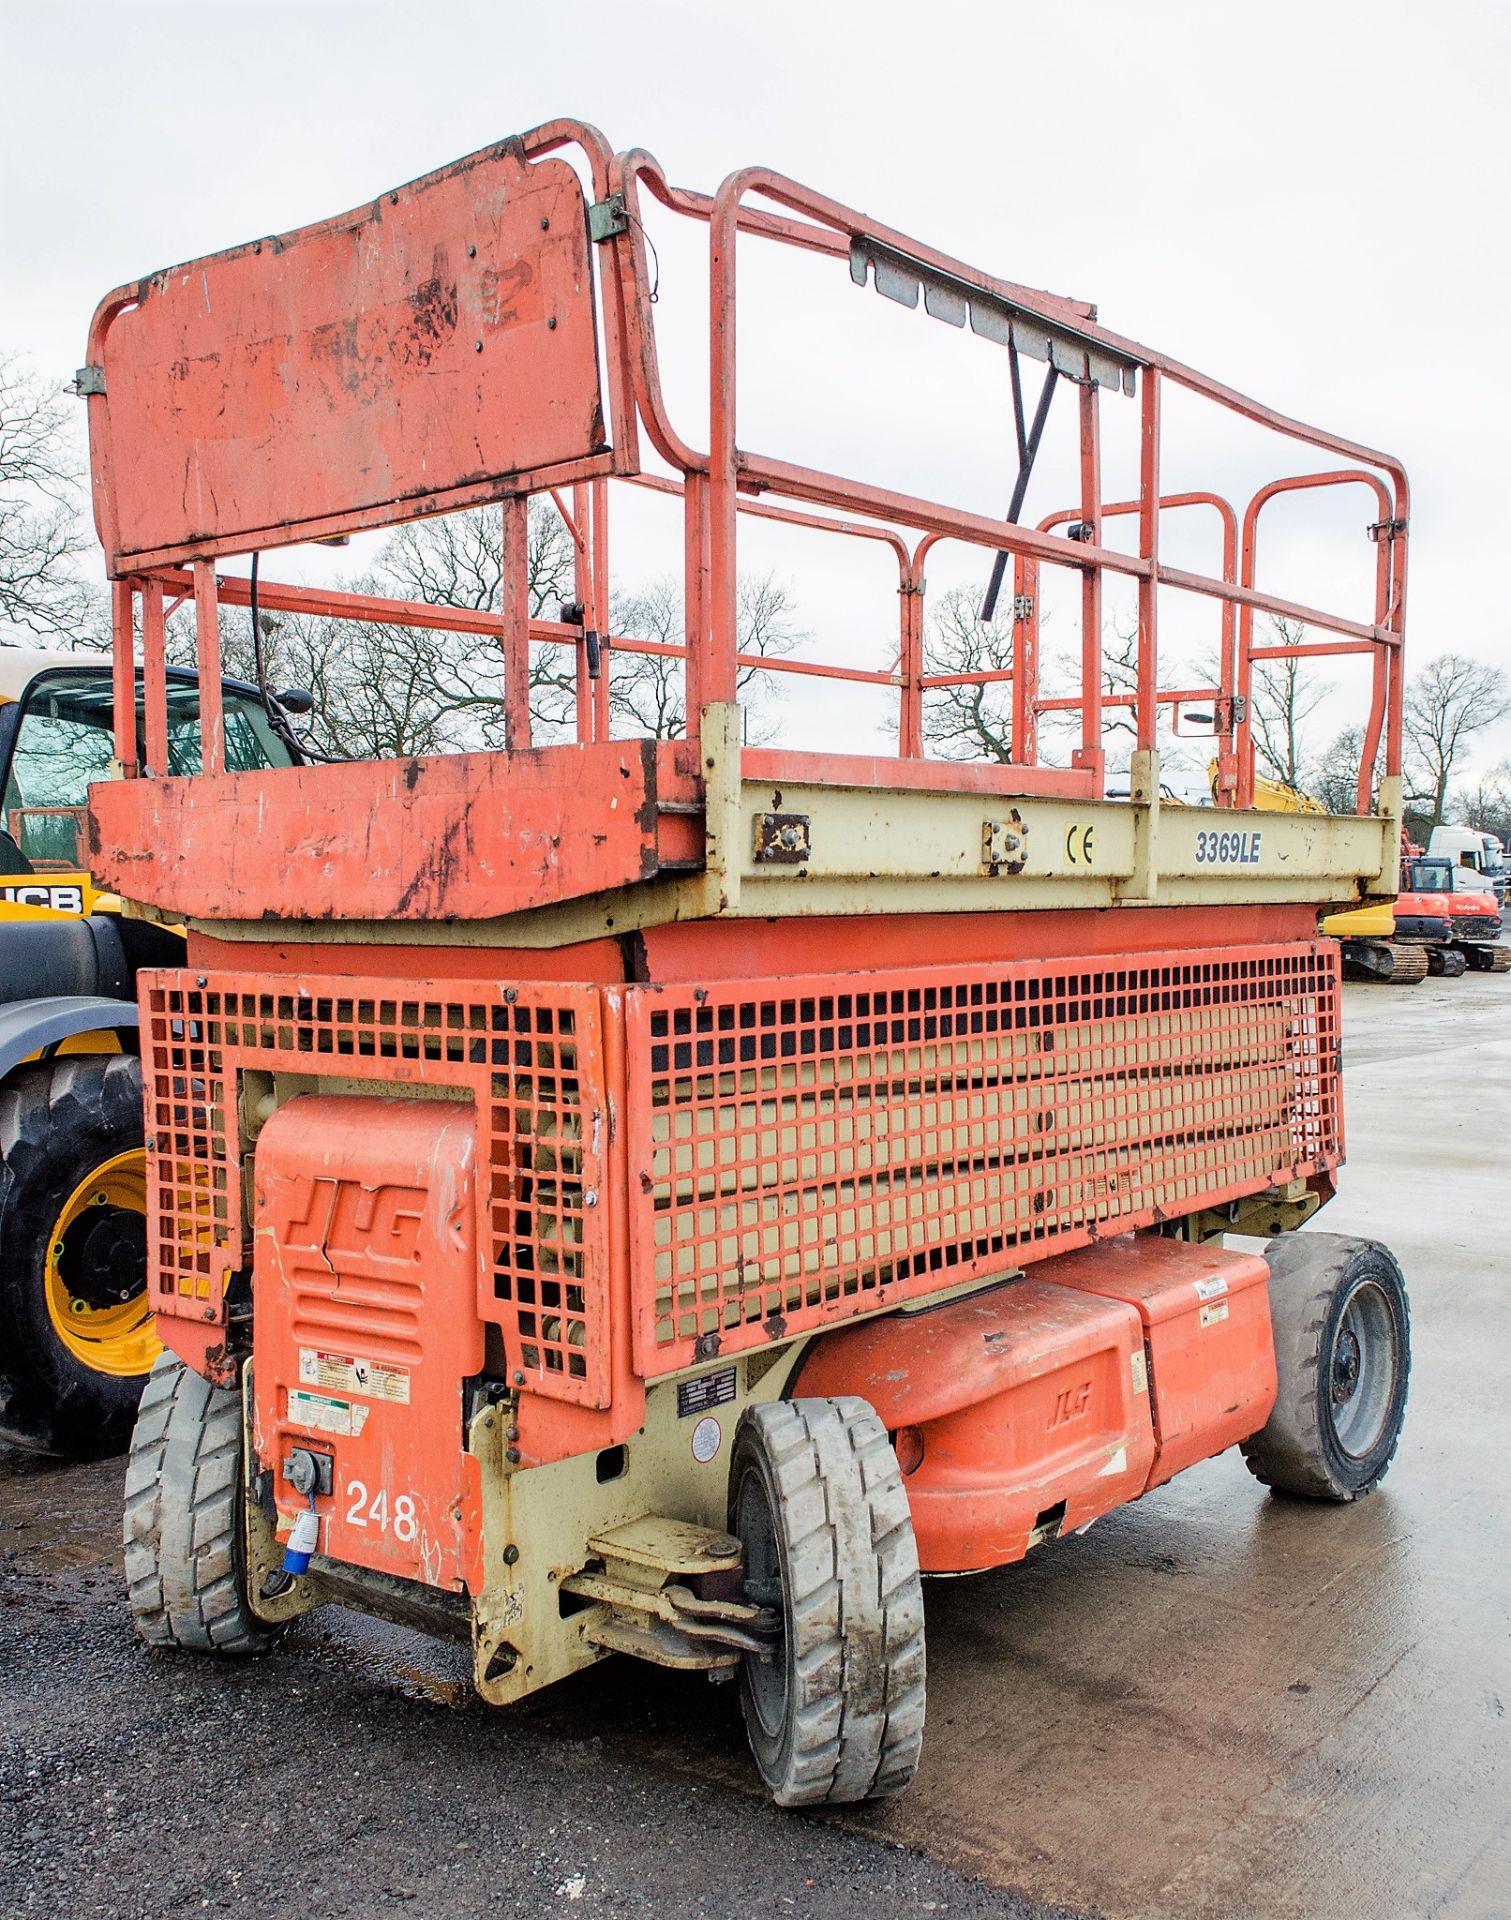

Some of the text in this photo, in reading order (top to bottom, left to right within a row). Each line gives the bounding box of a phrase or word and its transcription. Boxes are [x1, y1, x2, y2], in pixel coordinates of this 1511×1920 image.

[1195, 832, 1262, 863] 3369LE
[284, 1177, 428, 1264] JLG
[1046, 1381, 1092, 1432] JLG
[346, 1480, 416, 1541] 248
